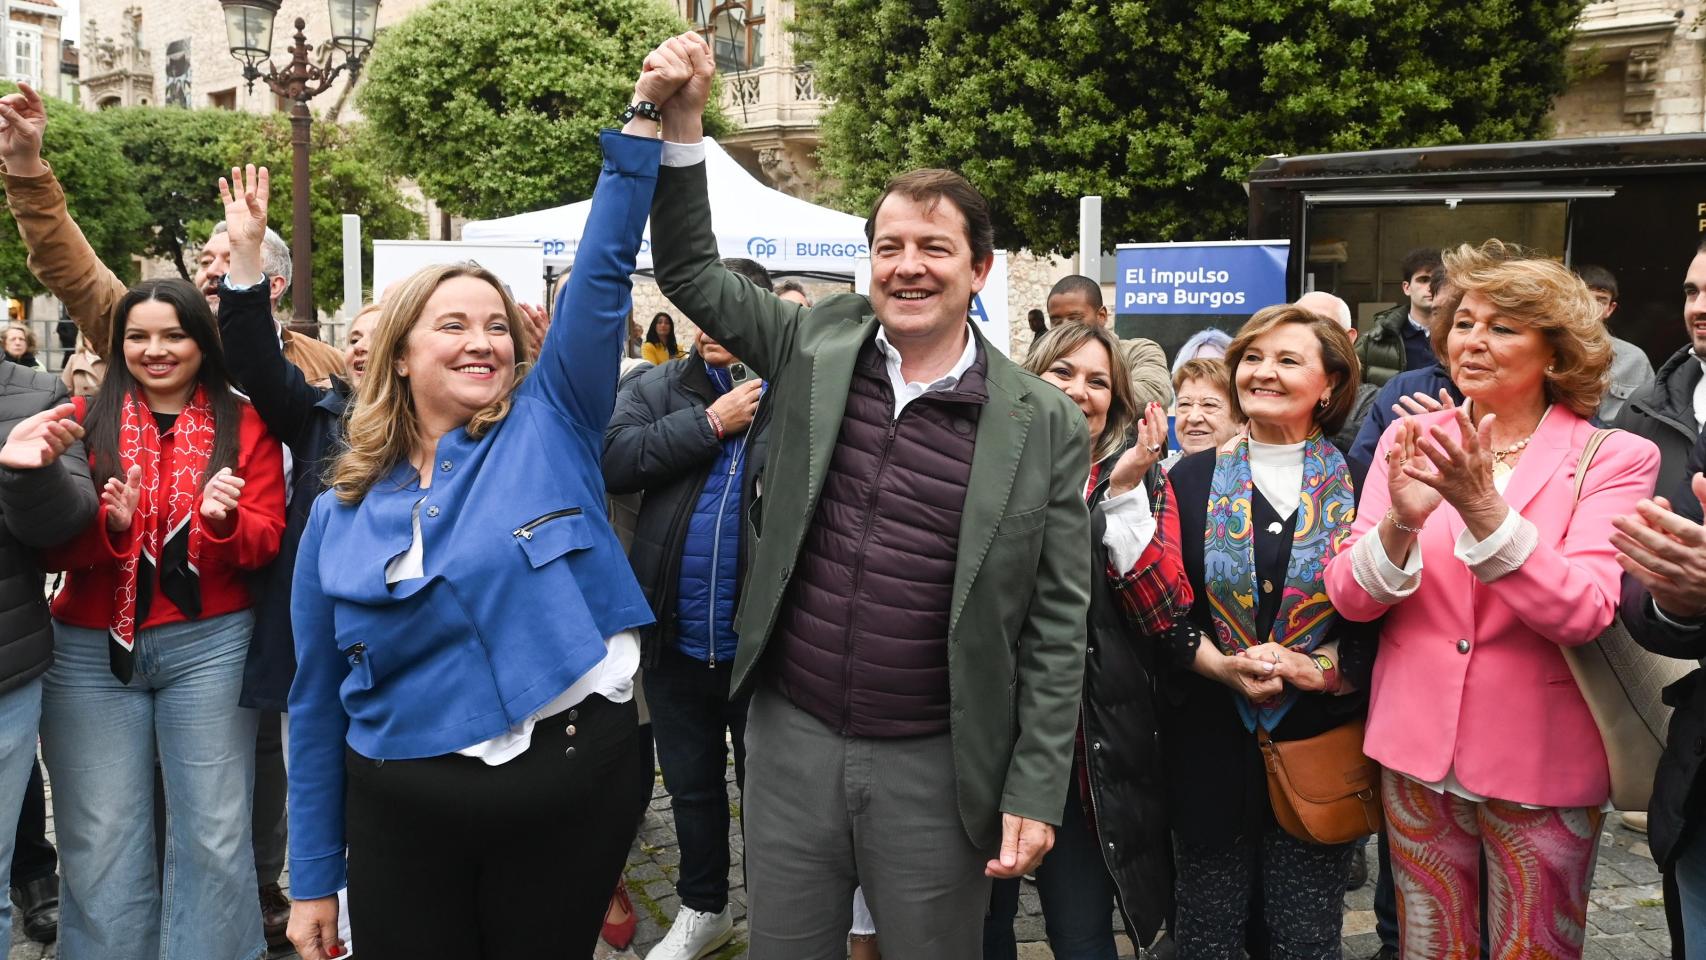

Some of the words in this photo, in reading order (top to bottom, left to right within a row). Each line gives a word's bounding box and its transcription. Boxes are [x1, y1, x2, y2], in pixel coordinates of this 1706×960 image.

[796, 243, 867, 257] BURGOS
[1125, 268, 1146, 284] El
[1151, 267, 1229, 287] impulso
[1125, 292, 1168, 308] para
[1174, 289, 1245, 308] Burgos
